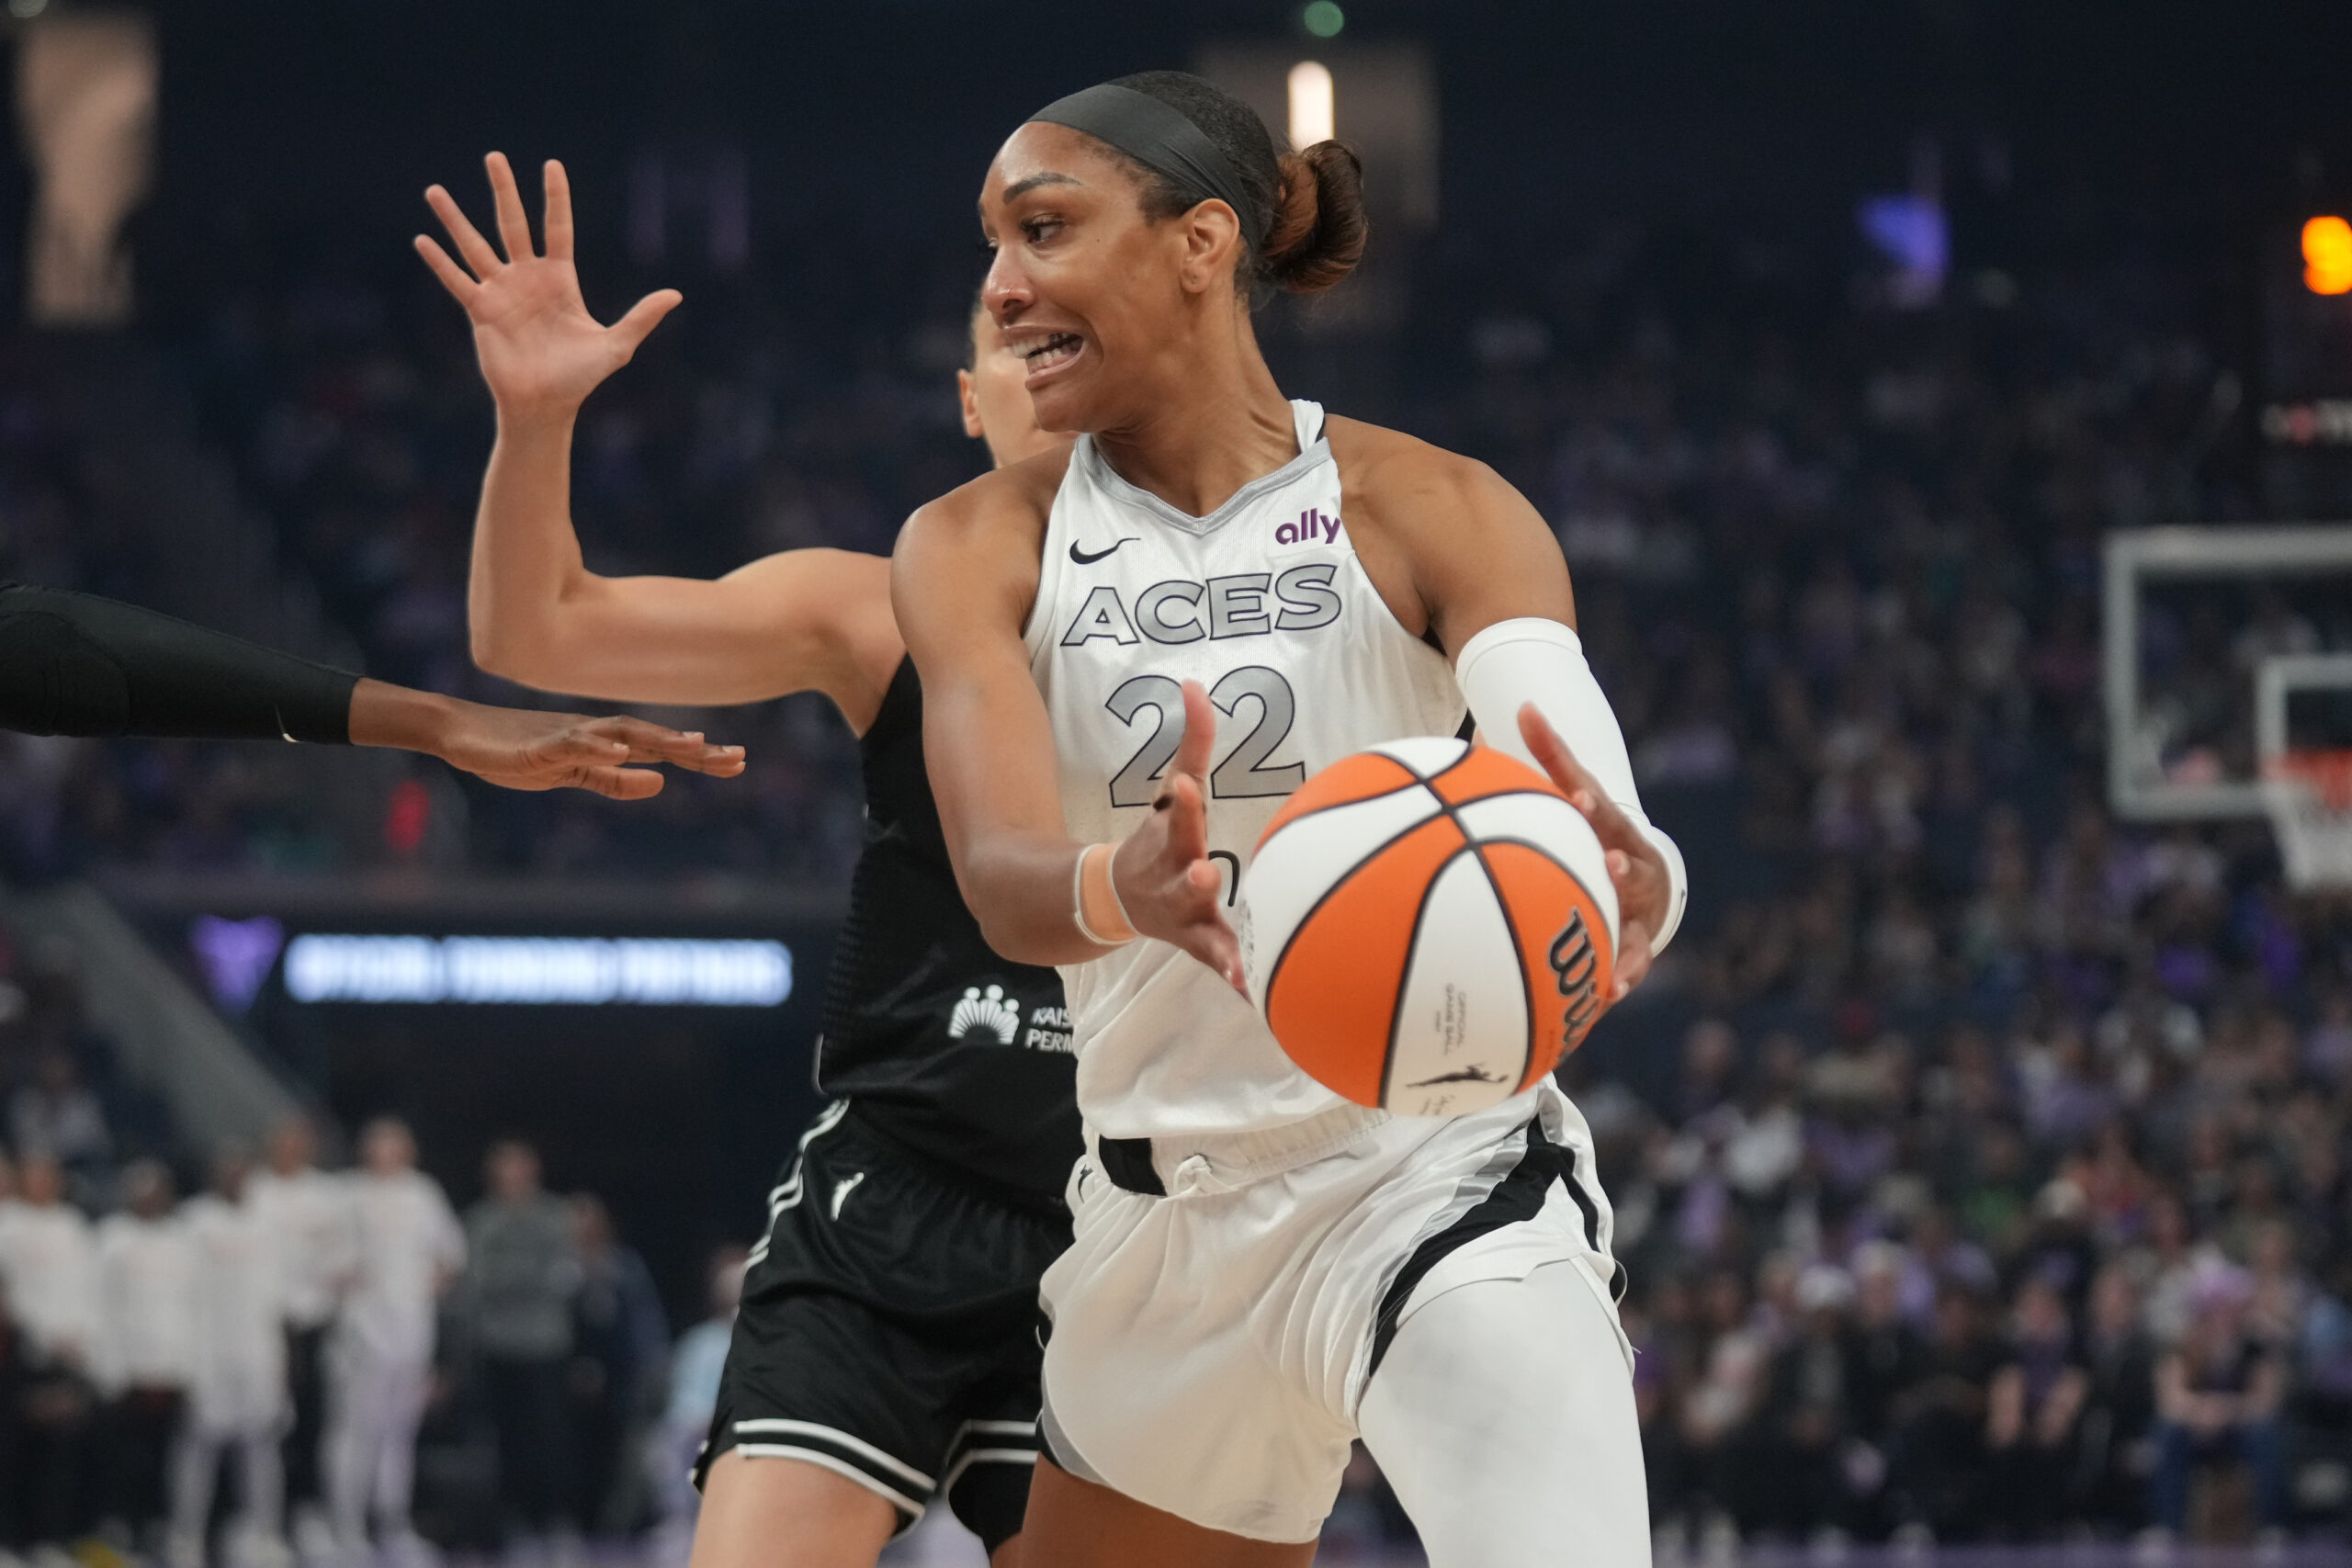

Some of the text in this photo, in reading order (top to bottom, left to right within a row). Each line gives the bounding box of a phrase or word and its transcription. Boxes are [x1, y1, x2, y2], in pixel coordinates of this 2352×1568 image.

[1275, 507, 1341, 545] ally
[1060, 563, 1341, 647] ACES
[1105, 665, 1306, 808] 22
[1031, 1006, 1073, 1028] KAIS
